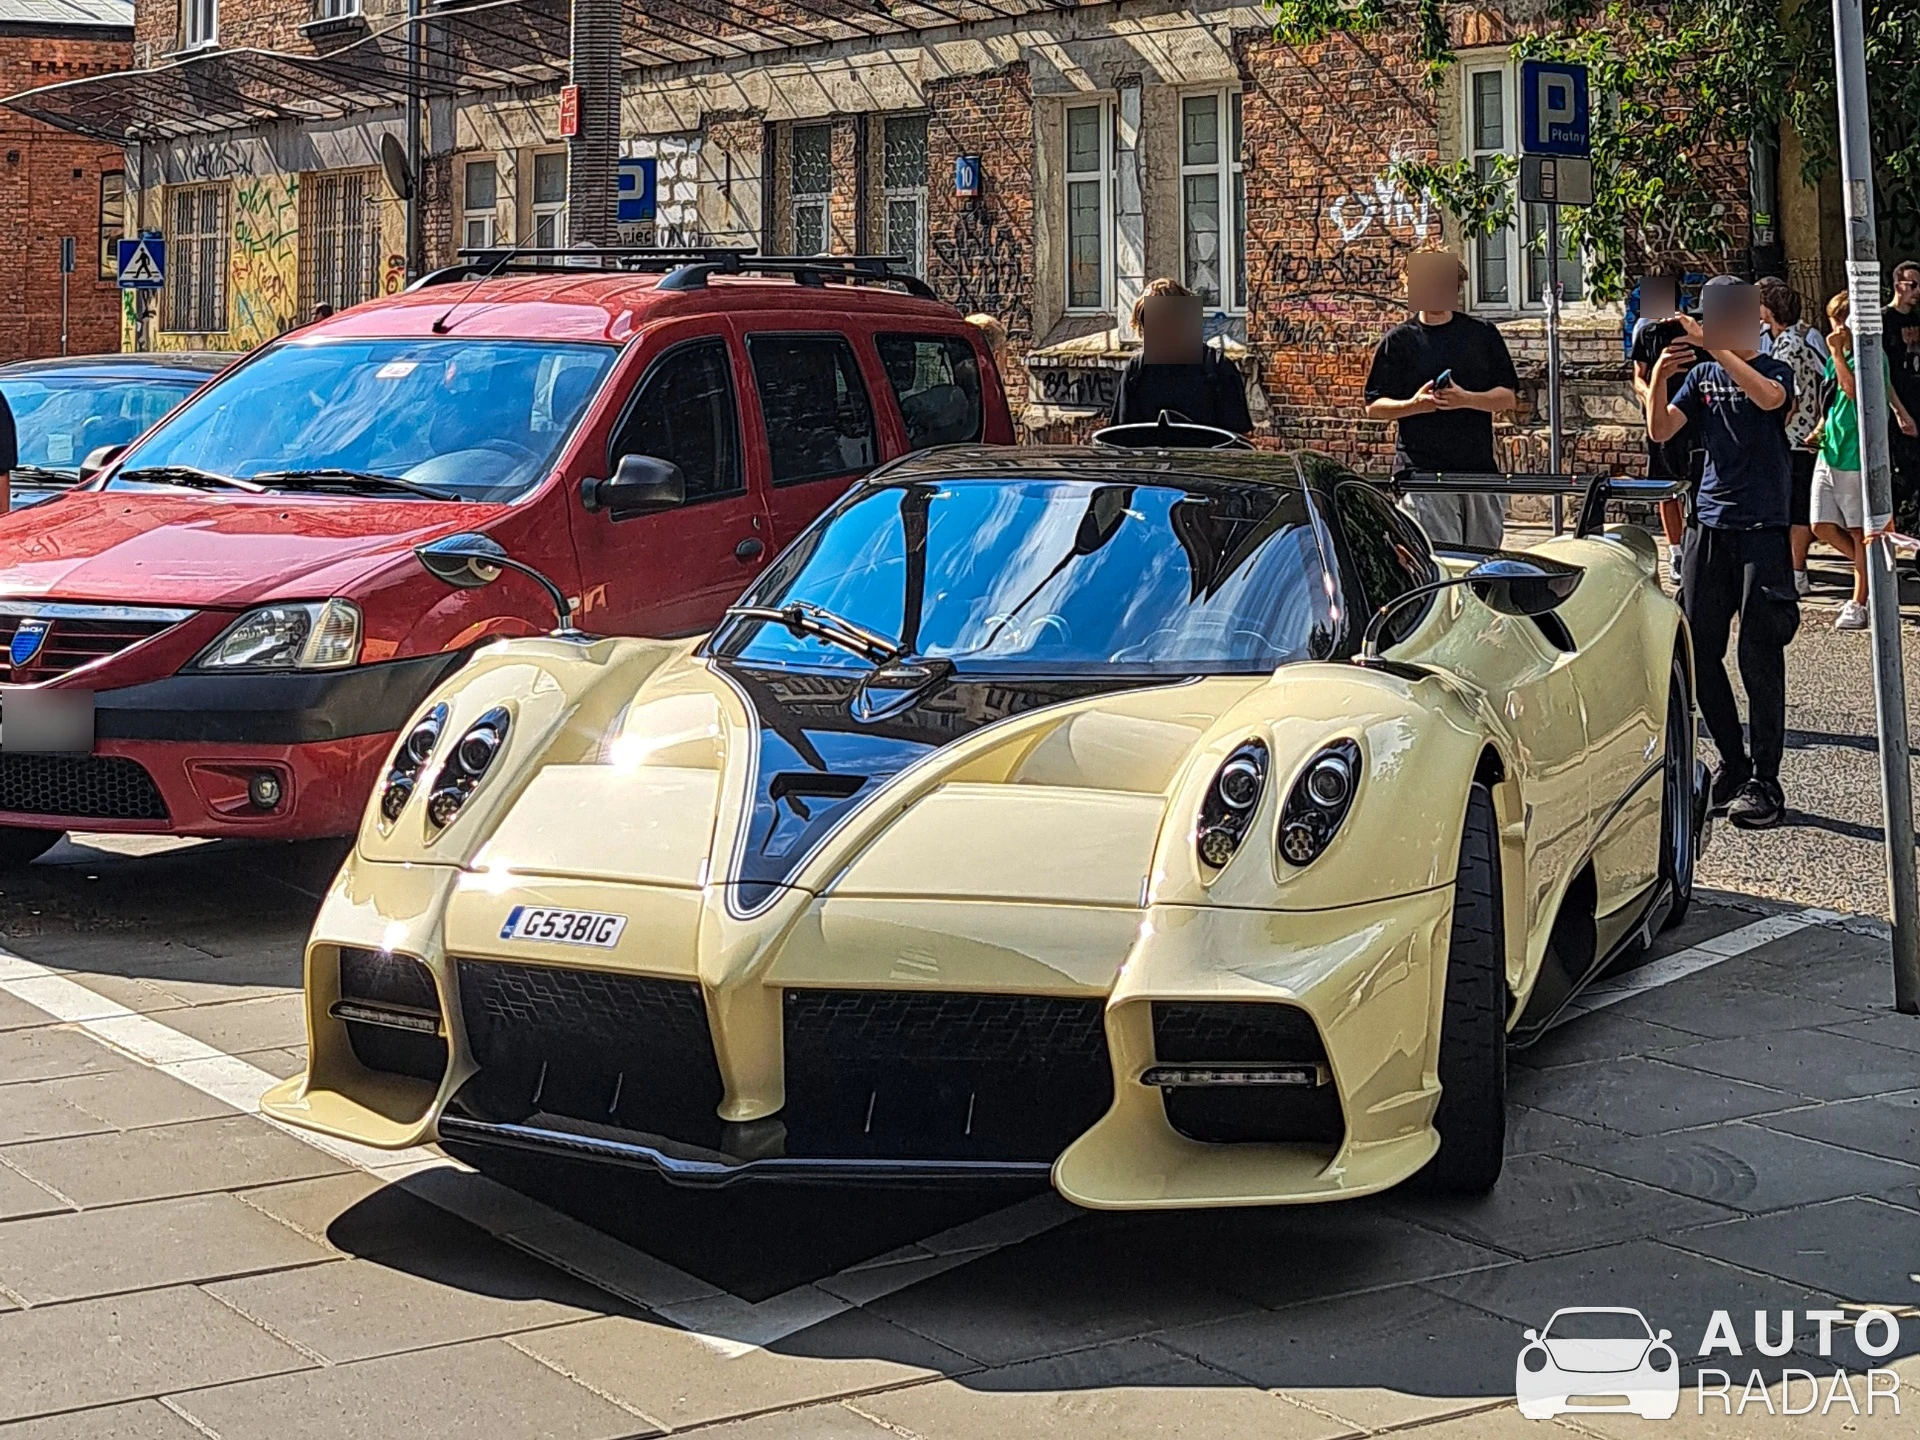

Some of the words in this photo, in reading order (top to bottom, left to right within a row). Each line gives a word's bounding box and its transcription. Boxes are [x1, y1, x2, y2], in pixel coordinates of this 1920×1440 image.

[1538, 71, 1576, 143] P
[961, 166, 973, 187] 10
[19, 626, 44, 634] DACIA
